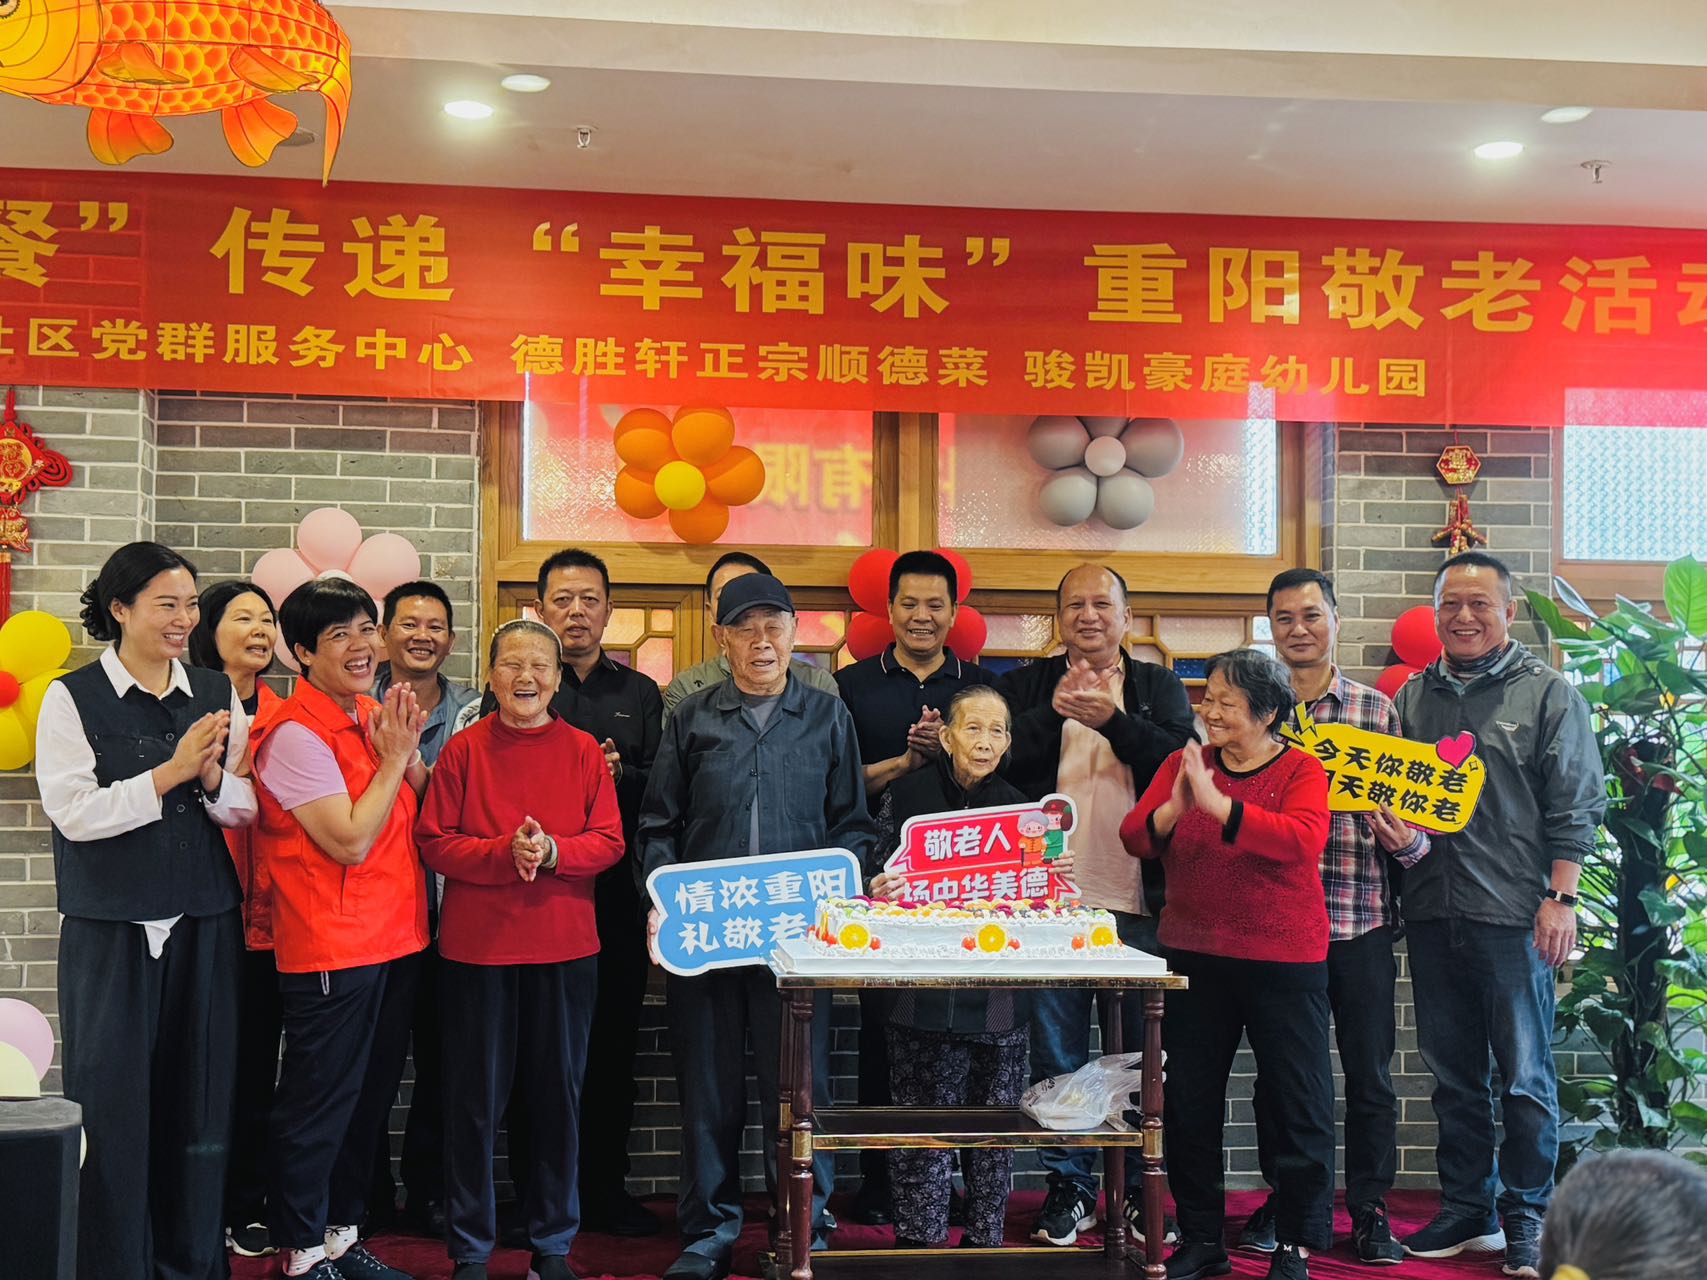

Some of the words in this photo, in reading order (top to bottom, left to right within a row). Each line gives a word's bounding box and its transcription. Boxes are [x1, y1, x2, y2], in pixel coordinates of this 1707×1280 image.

[210, 206, 455, 301] 传递
[532, 221, 1010, 318] “幸福味”
[0, 315, 473, 371] 区党群服务中心
[510, 334, 989, 387] 德胜轩正宗顺德菜
[1024, 350, 1427, 397] 骏凯豪庭幼儿园
[1313, 738, 1468, 794] 今天你敬老
[1325, 770, 1461, 822] 天敬你老
[924, 823, 1011, 860] 敬老人
[675, 868, 847, 914] 情浓重阳
